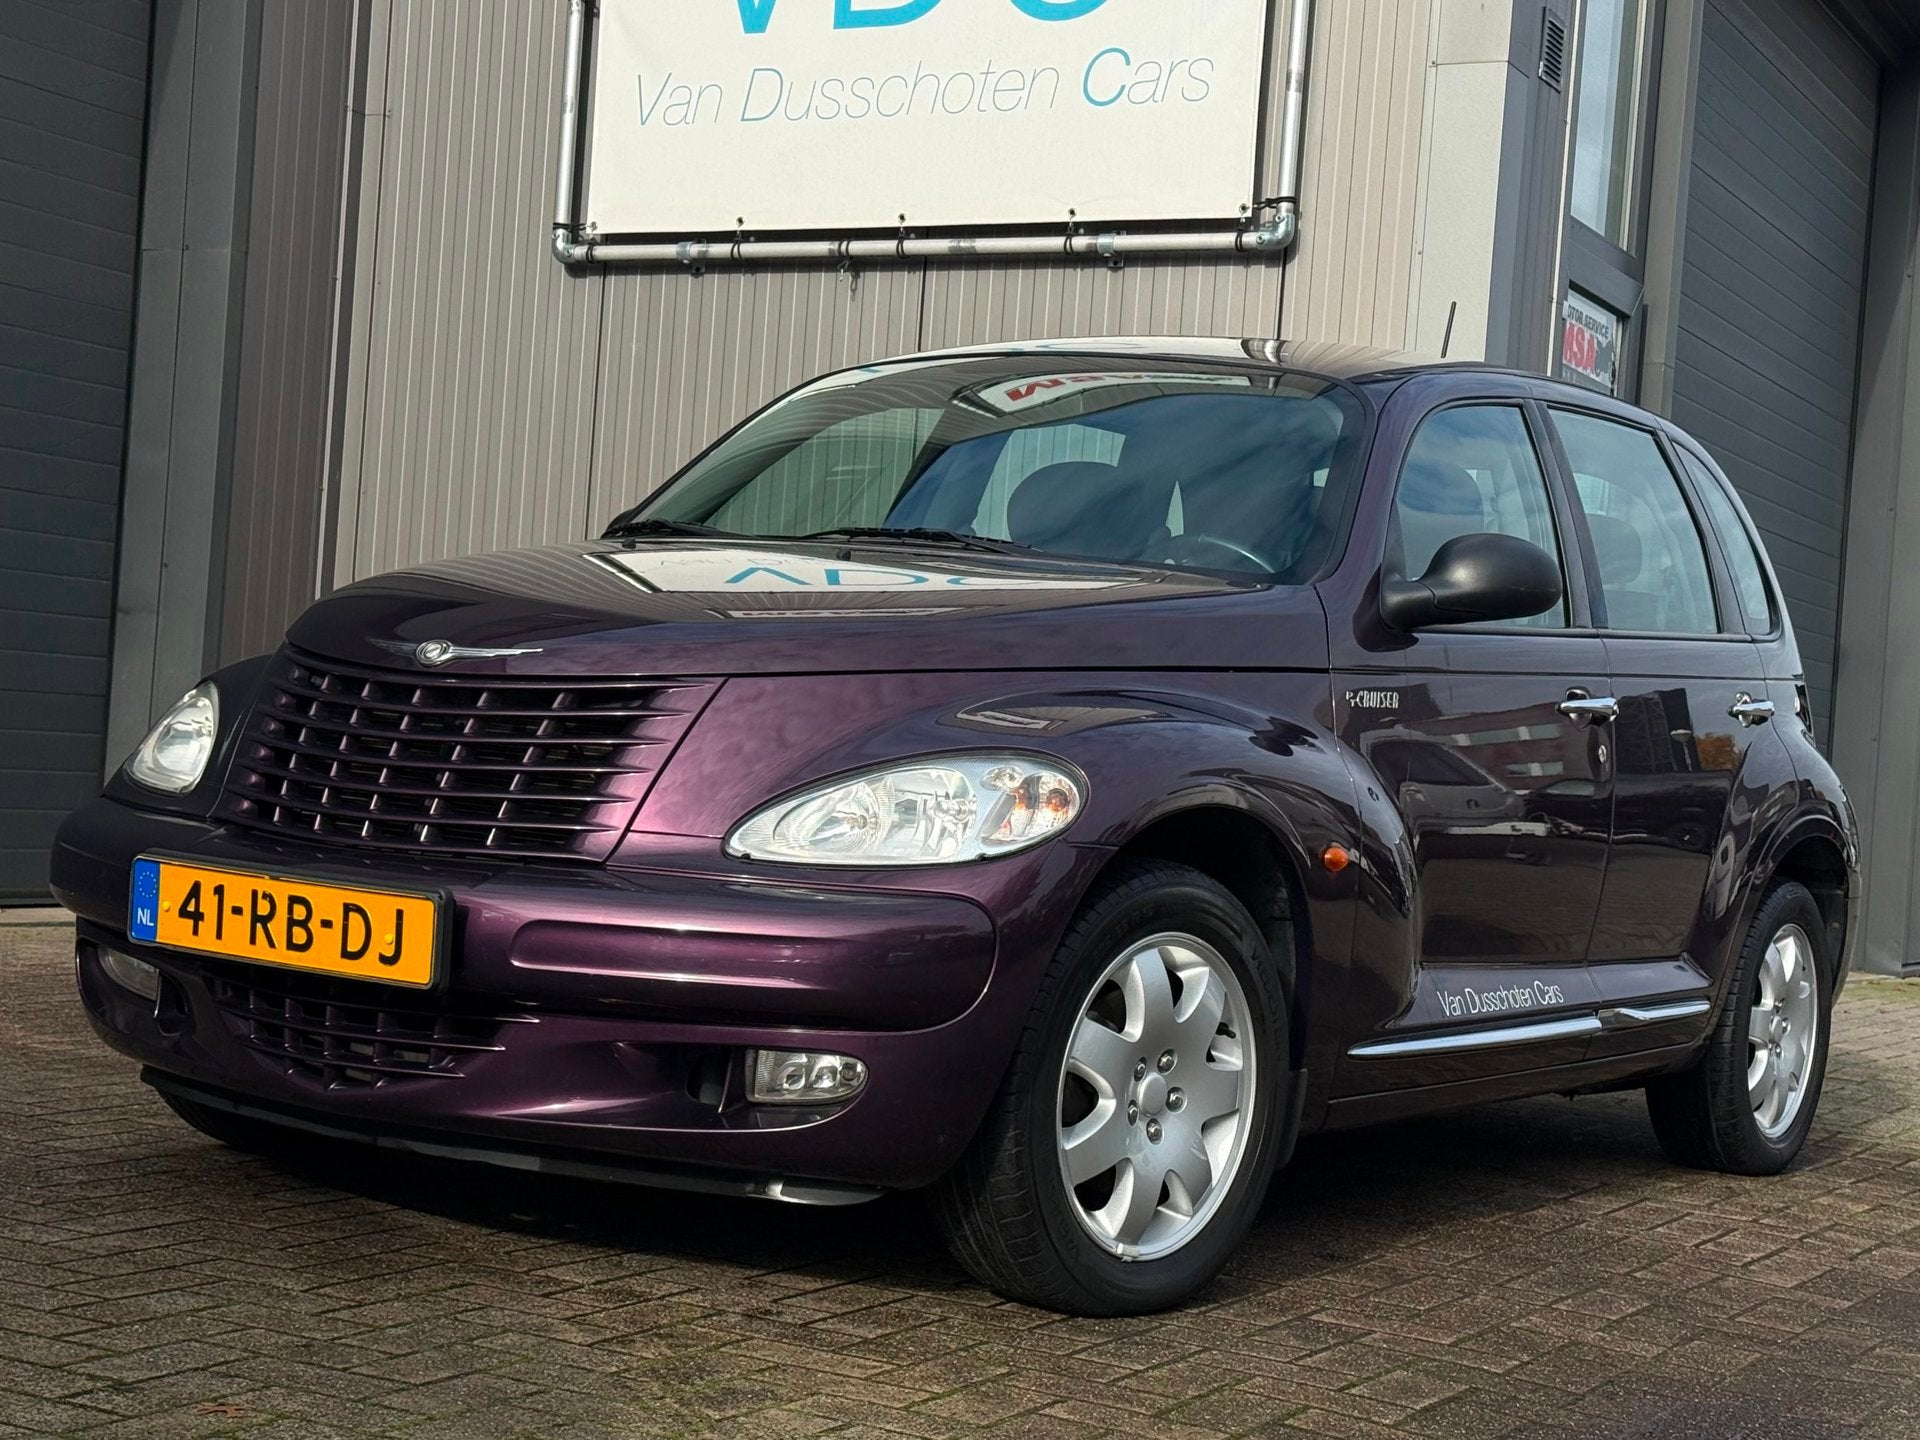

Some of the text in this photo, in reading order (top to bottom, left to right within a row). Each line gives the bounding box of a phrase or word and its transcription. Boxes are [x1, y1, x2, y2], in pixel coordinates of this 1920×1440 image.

[636, 47, 1215, 127] Van Dusschoten Cars
[1356, 690, 1399, 708] CRUISER
[137, 907, 154, 927] NL
[178, 880, 404, 967] 41-RB-DJ
[1437, 980, 1564, 1016] Van Dusschoten Cars
